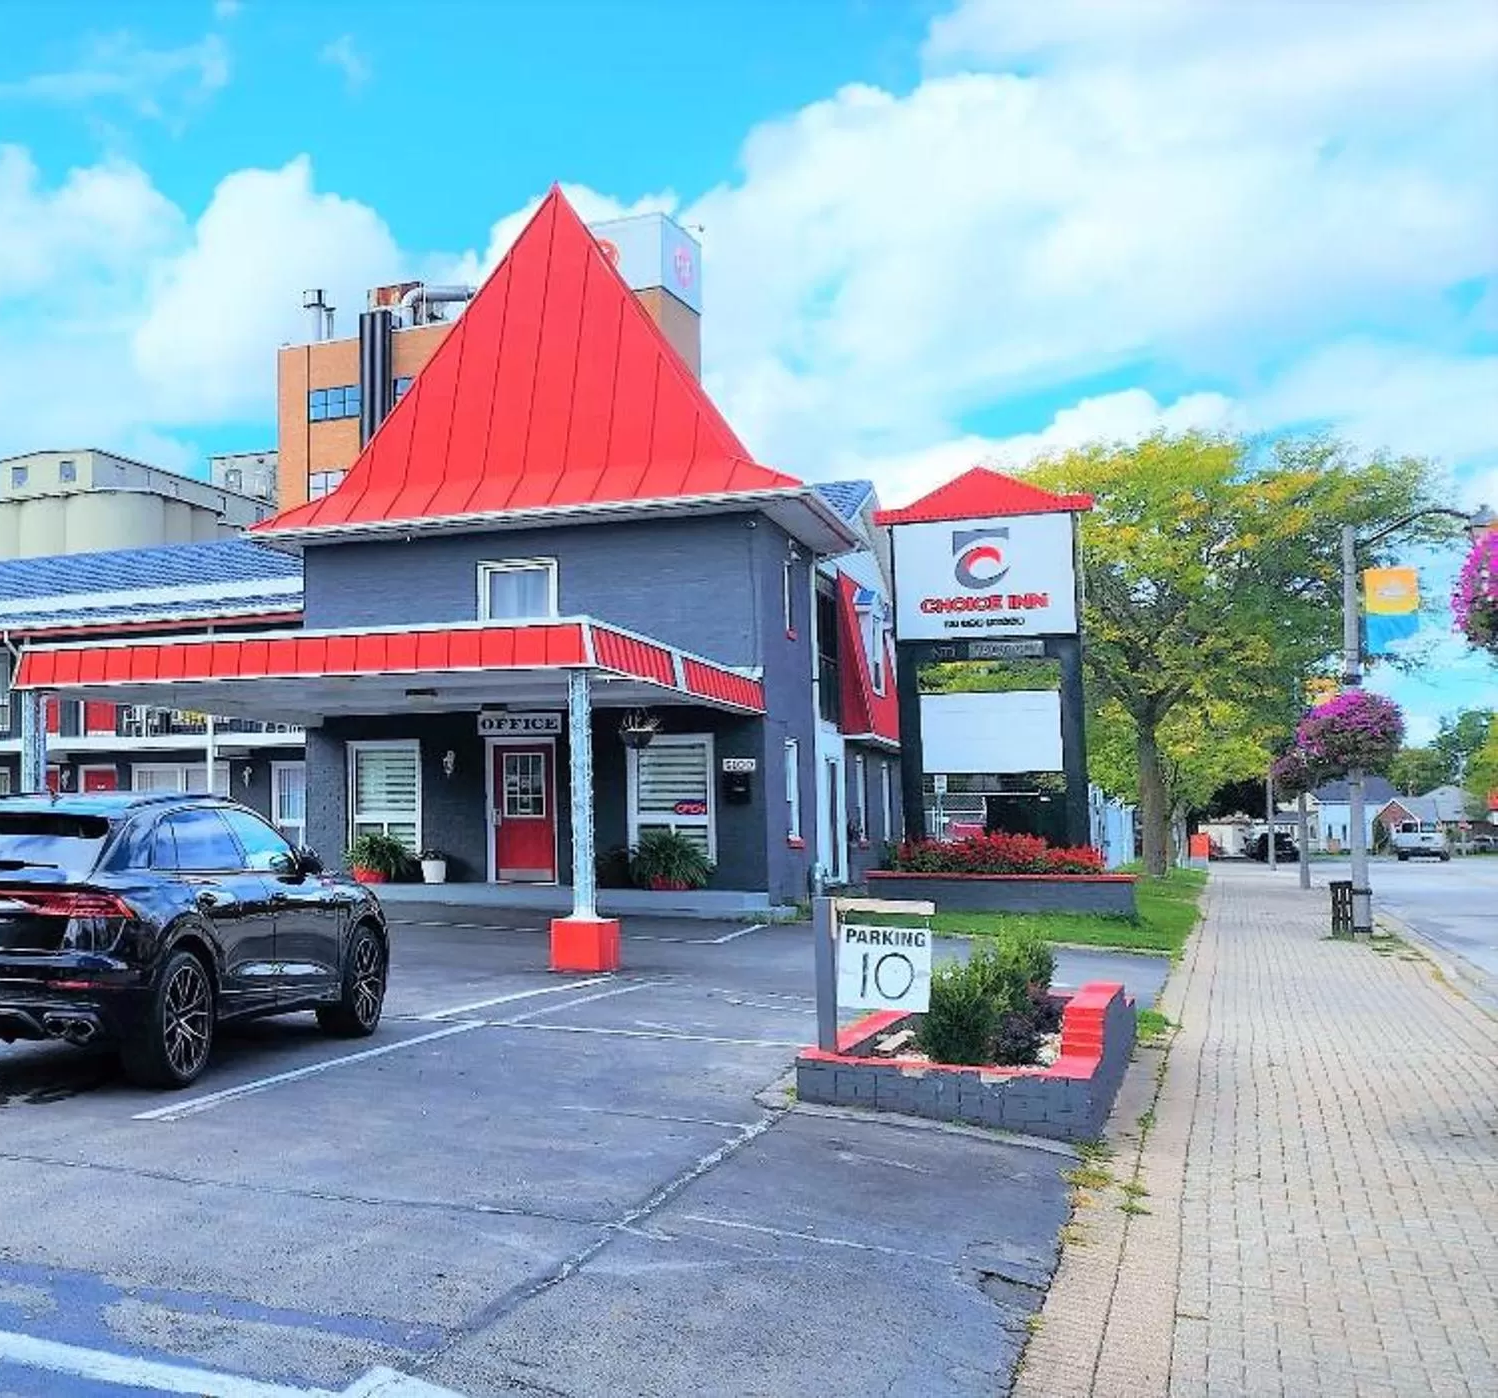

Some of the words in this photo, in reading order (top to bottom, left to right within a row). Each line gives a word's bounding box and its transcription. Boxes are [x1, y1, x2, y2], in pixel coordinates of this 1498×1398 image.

[920, 594, 1002, 614] CHOICE
[1007, 592, 1049, 609] INN
[481, 718, 558, 730] OFFICE
[845, 928, 926, 947] PARKING
[860, 952, 915, 1000] 10
